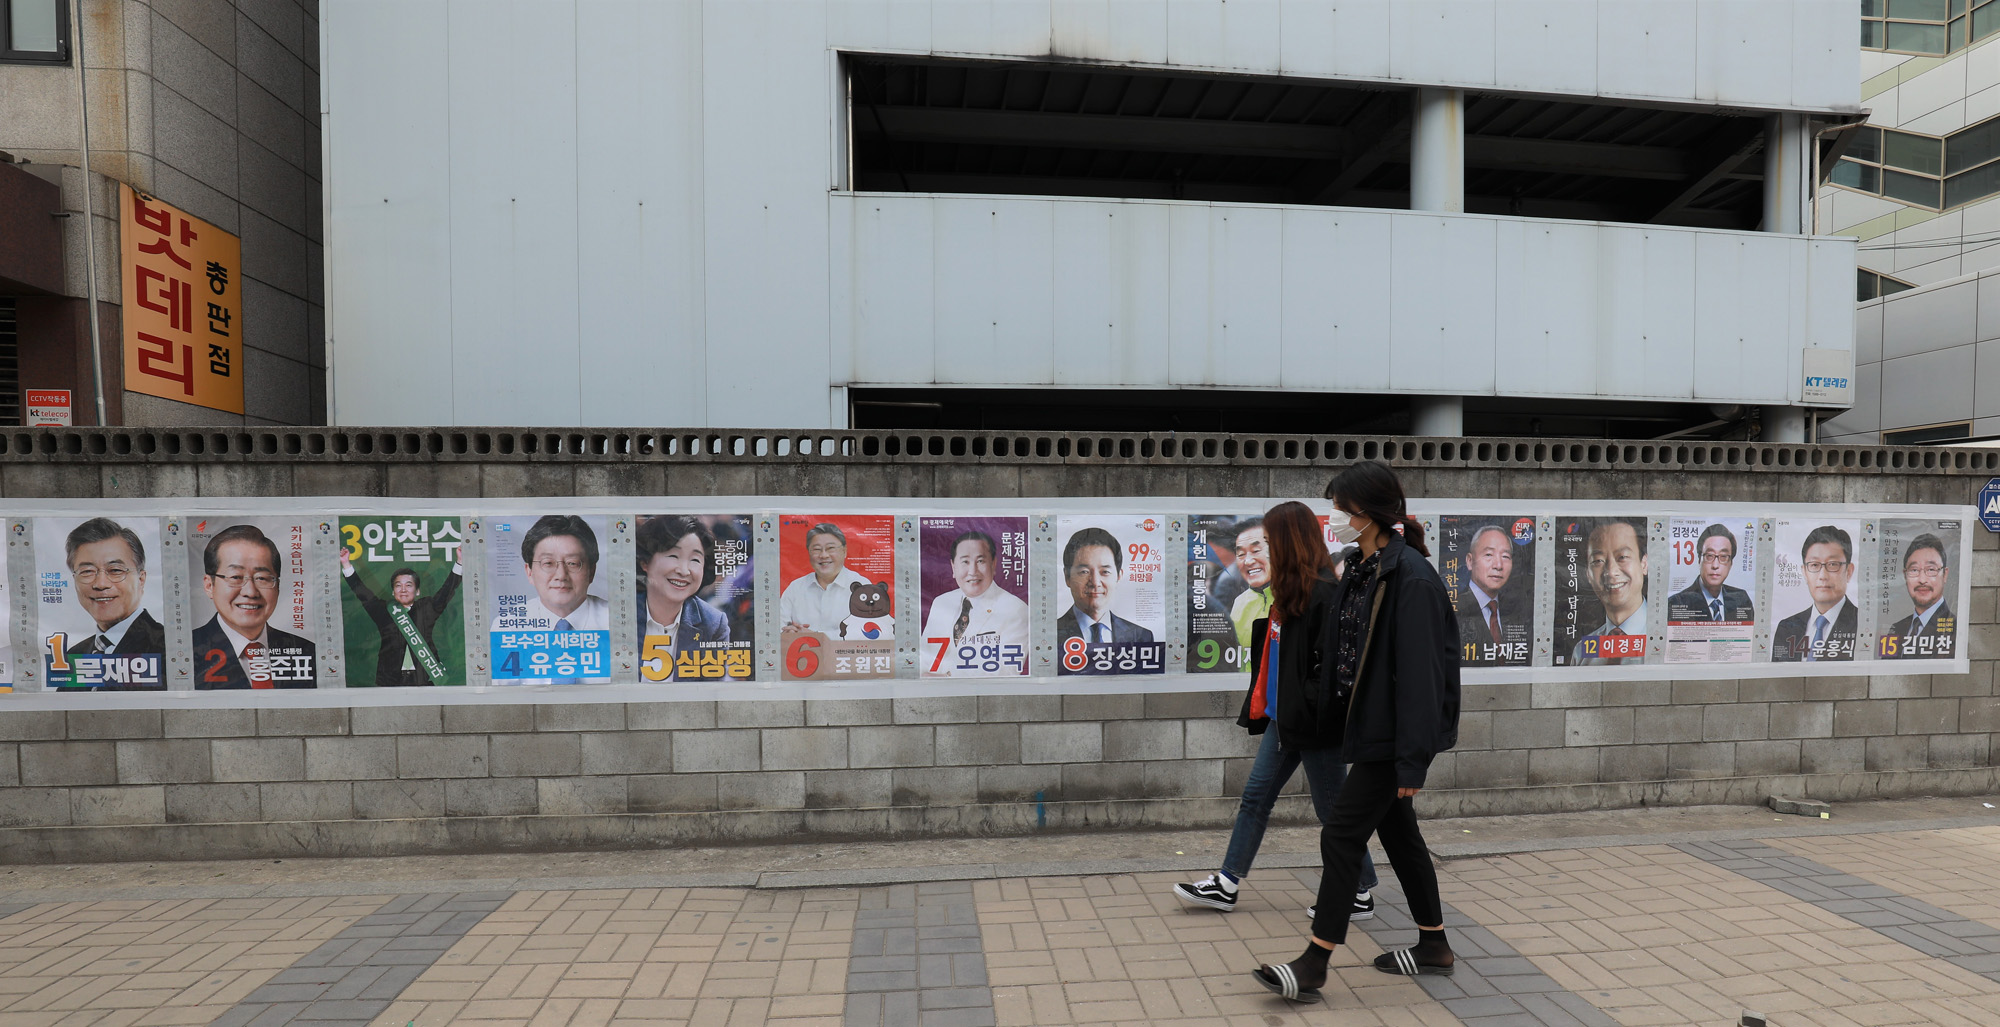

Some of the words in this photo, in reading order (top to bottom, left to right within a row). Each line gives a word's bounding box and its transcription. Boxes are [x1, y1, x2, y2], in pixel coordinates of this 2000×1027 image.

[134, 198, 198, 396] 밧데리
[206, 260, 231, 377] 총판점
[1515, 532, 1533, 541] 보수!
[1516, 522, 1529, 531] 진짜
[1672, 527, 1699, 538] 김정선
[291, 526, 303, 575] 지키겠습니다
[714, 540, 747, 552] 노동이
[1193, 530, 1206, 559] 개헌
[1448, 528, 1458, 551] 나는
[714, 553, 748, 565] 당당한
[1002, 532, 1012, 580] 문제는?
[1014, 532, 1025, 586] 경제다!!
[1128, 543, 1161, 561] 99%
[1673, 541, 1694, 565] 13
[715, 565, 737, 578] 나라
[1129, 564, 1161, 573] 국민에게
[1129, 573, 1153, 582] 희망을
[1567, 549, 1578, 592] 통일이
[1192, 564, 1207, 610] 대통령
[1882, 558, 1890, 614] 보호하겠습니다
[293, 581, 304, 630] 자유대한민국
[498, 595, 527, 605] 당신의
[498, 606, 527, 617] 능력을
[499, 618, 550, 628] 보여주세요!
[1566, 595, 1579, 639] 답이다
[46, 632, 72, 673] 1
[397, 613, 423, 646] 국민이
[418, 646, 444, 679] 이긴다
[501, 633, 549, 649] 보수의
[552, 632, 600, 648] 새희망
[1484, 643, 1528, 660] 남재준
[1584, 640, 1597, 654] 12
[1603, 638, 1644, 653] 이경희
[1786, 635, 1810, 658] 14
[1812, 640, 1855, 658] 윤홍식
[1880, 637, 1898, 655] 15
[1902, 635, 1952, 654] 김민찬
[204, 649, 228, 682] 2
[501, 651, 523, 676] 4
[529, 651, 600, 675] 유승민
[640, 635, 674, 681] 5
[676, 650, 752, 678] 심상정
[786, 636, 821, 678] 6
[836, 657, 890, 673] 조원진
[928, 637, 951, 672] 7
[957, 644, 1024, 672] 오영국
[1063, 636, 1088, 672] 8
[1092, 646, 1160, 670] 장성민
[1197, 639, 1220, 669] 9
[74, 658, 158, 683] 문재인
[249, 656, 313, 682] 홍준표
